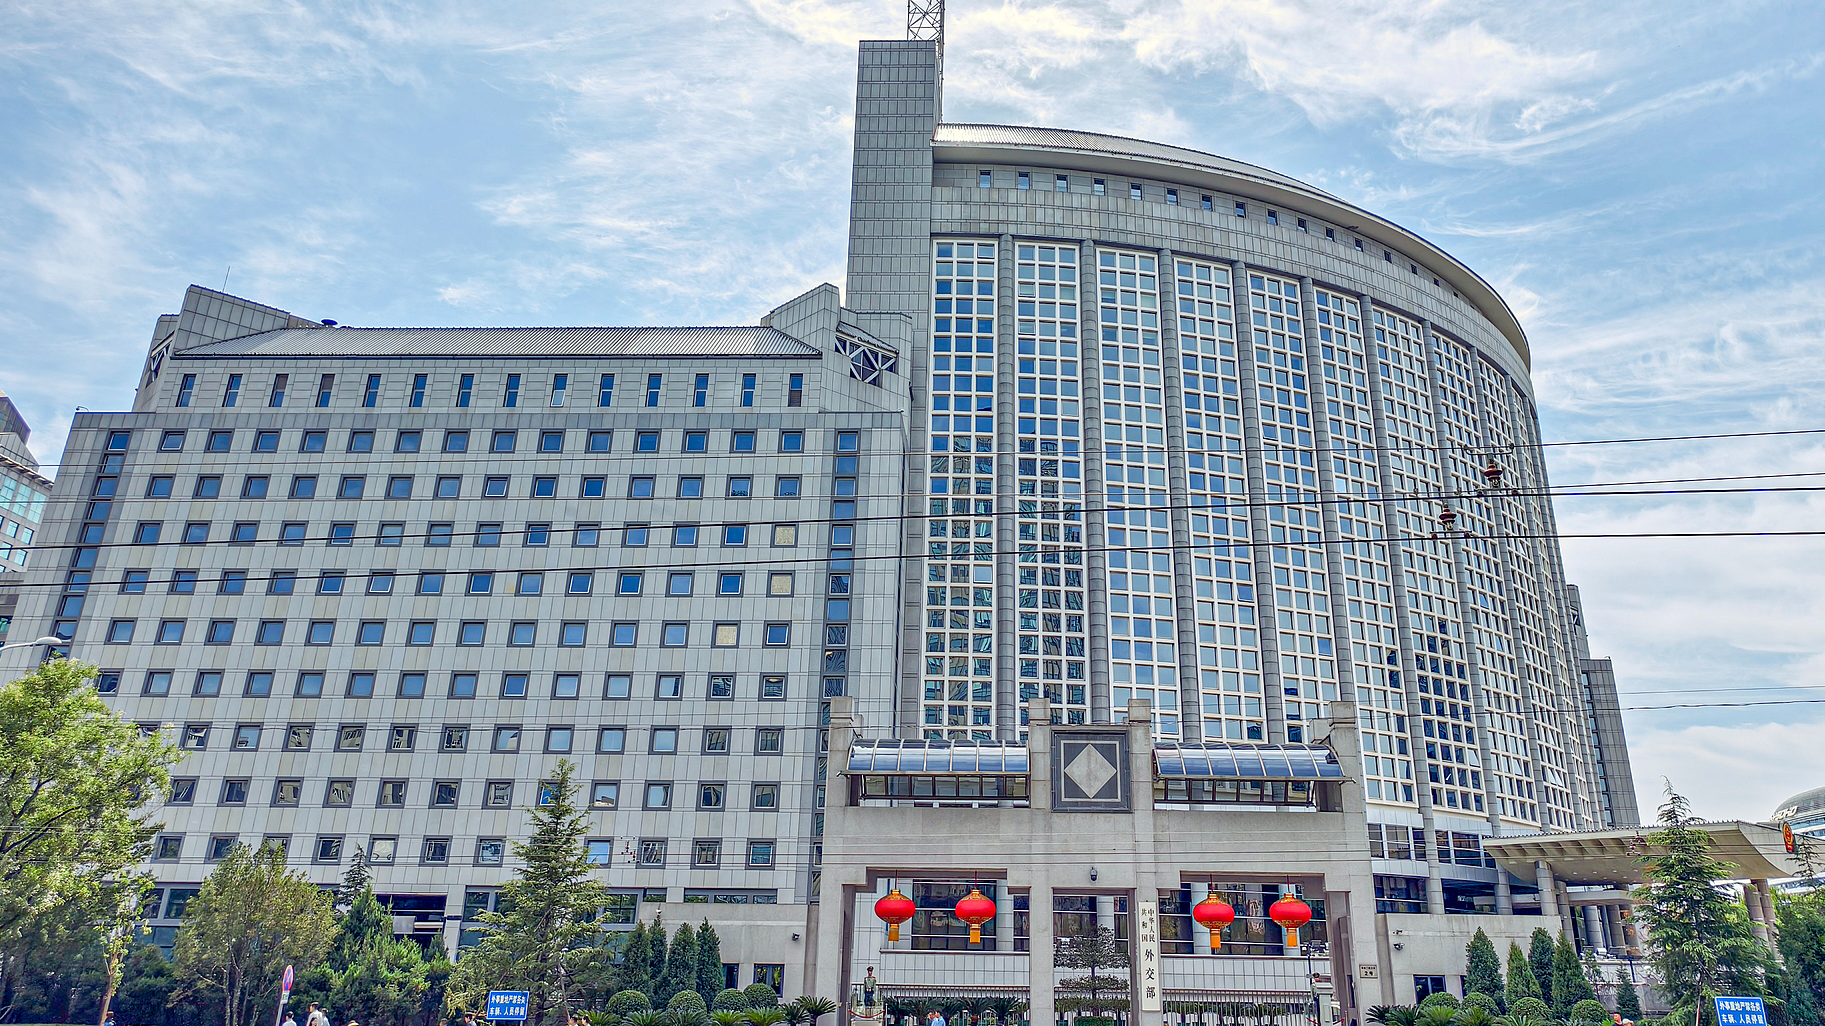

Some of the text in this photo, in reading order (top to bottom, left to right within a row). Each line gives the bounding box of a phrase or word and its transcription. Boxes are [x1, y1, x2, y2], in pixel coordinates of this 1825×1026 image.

[1148, 908, 1156, 943] 中华人民
[1145, 948, 1156, 999] 外交部
